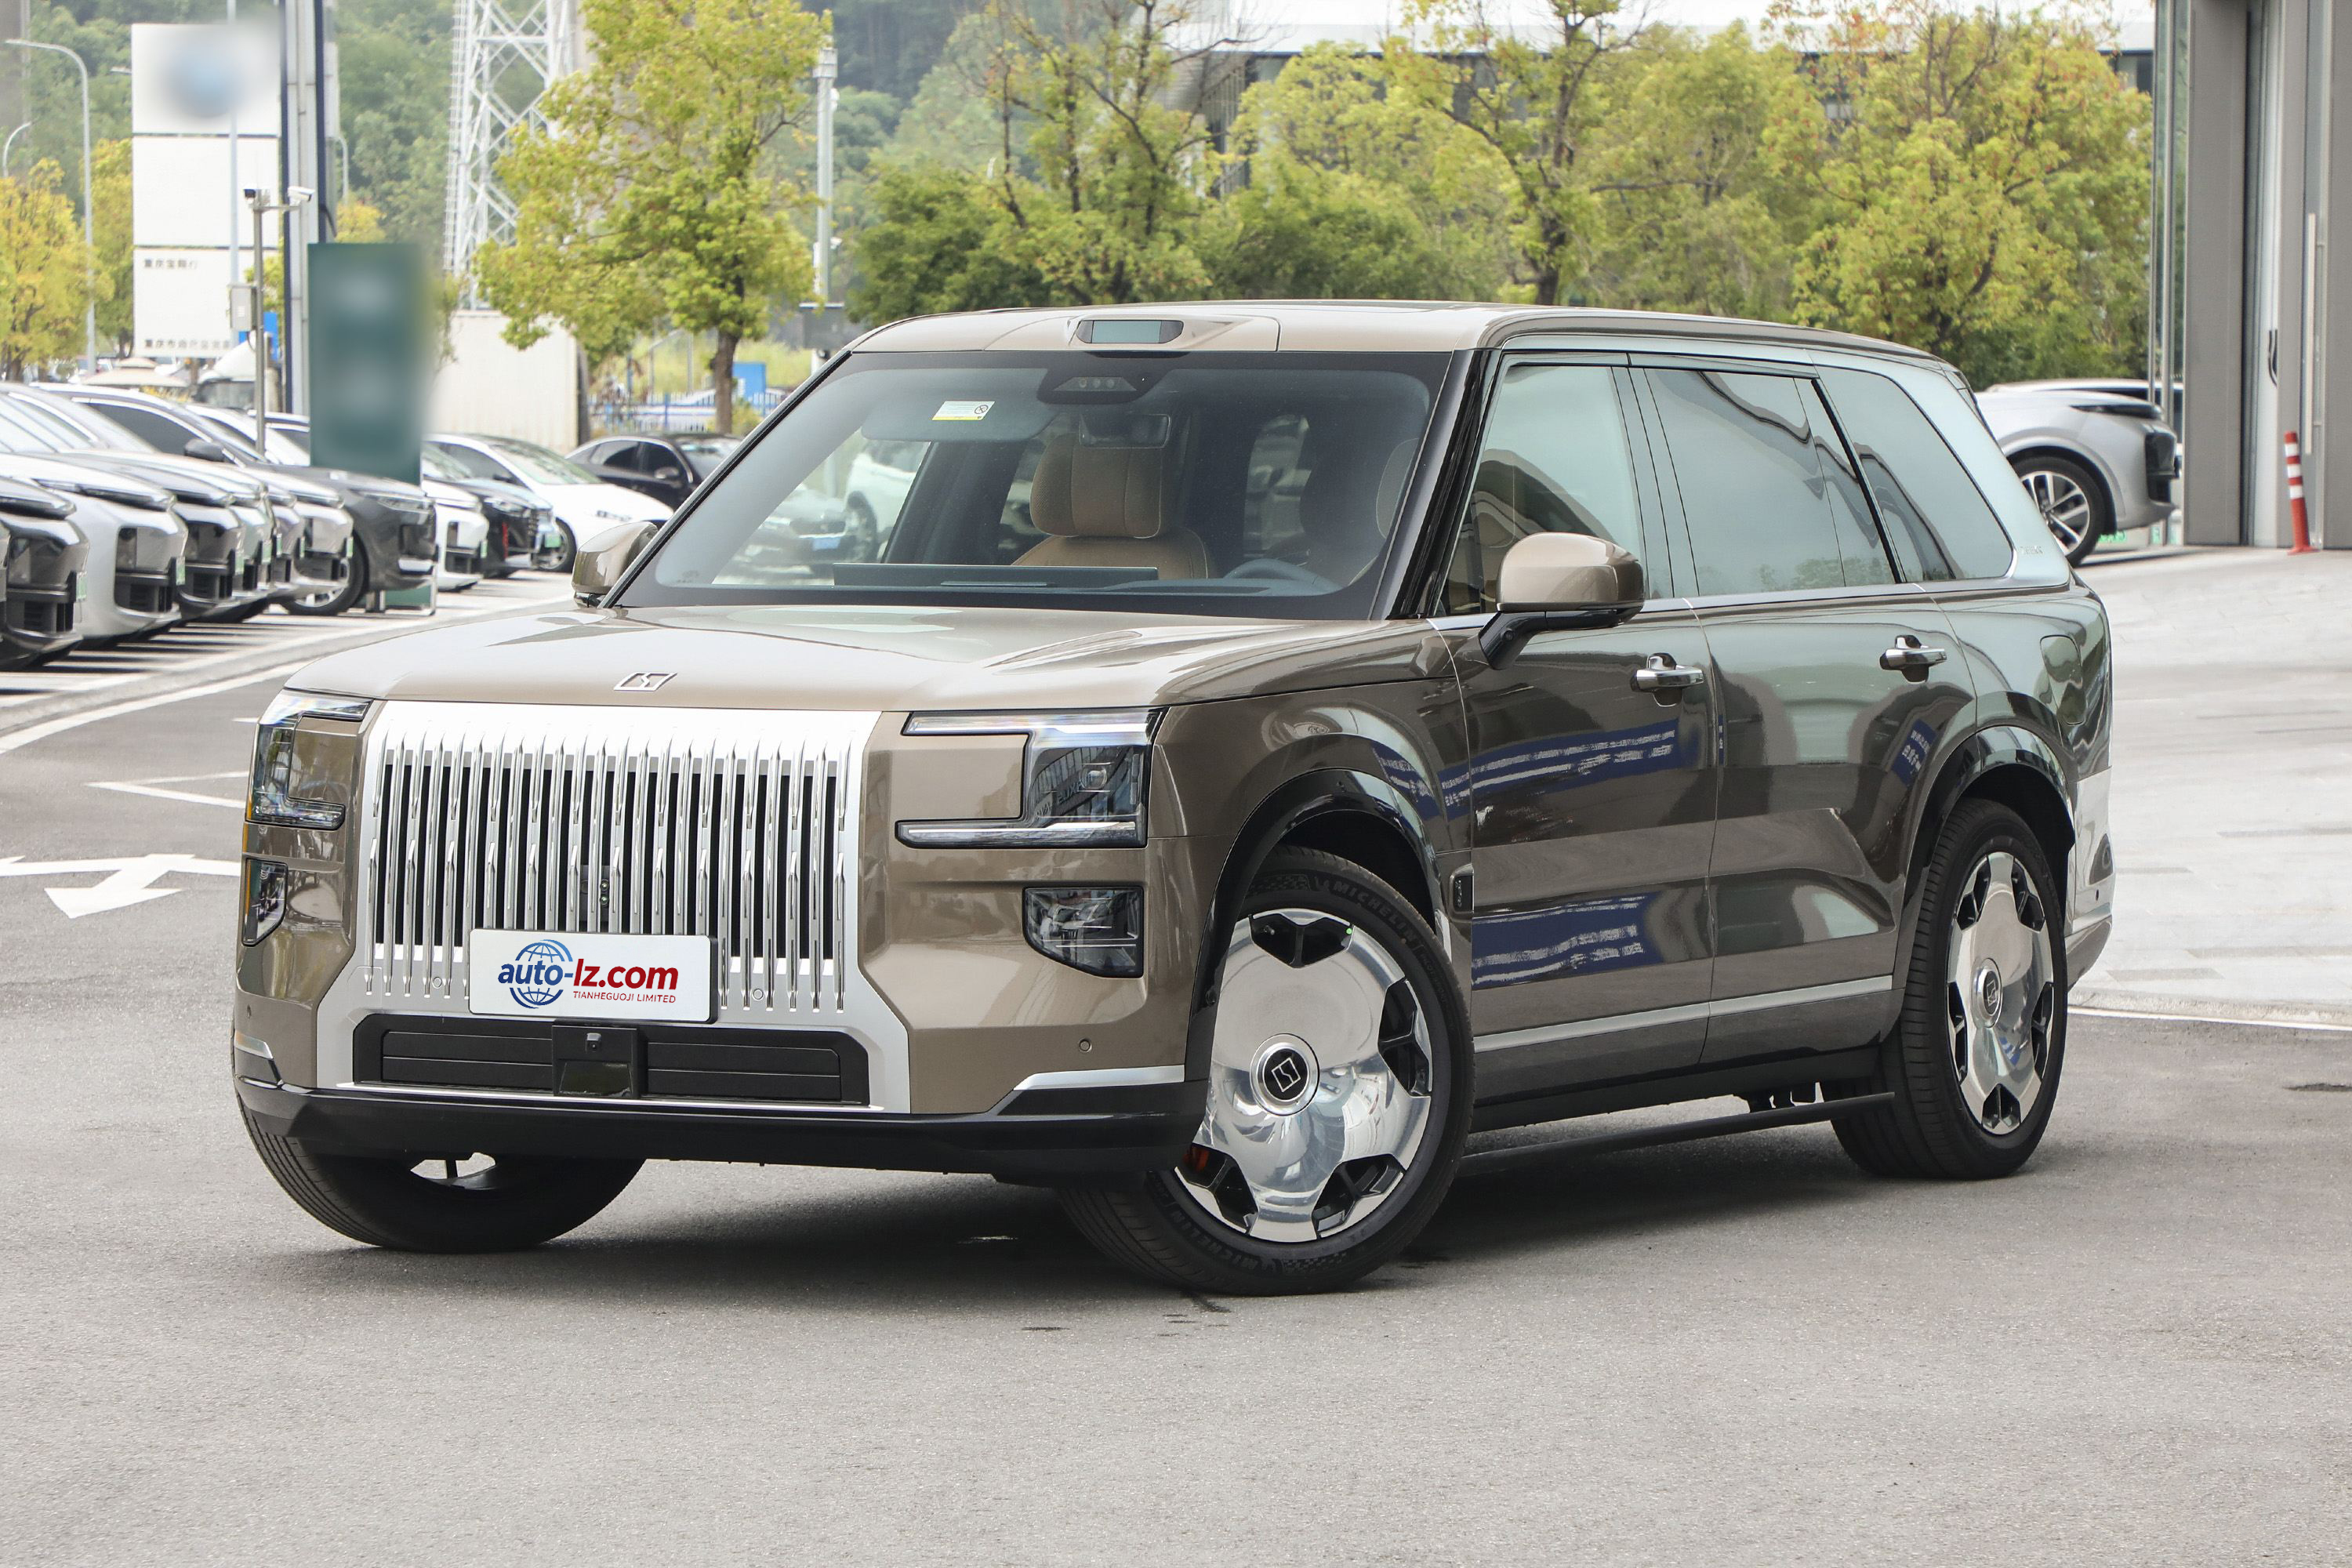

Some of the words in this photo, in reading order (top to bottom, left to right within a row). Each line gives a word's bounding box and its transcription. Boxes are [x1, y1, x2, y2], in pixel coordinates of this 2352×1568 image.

[1334, 880, 1419, 942] MICHELIN
[498, 958, 679, 990] auto-lz.com
[573, 991, 634, 1001] TIANHEGUOJI
[637, 993, 676, 1004] LIMITED
